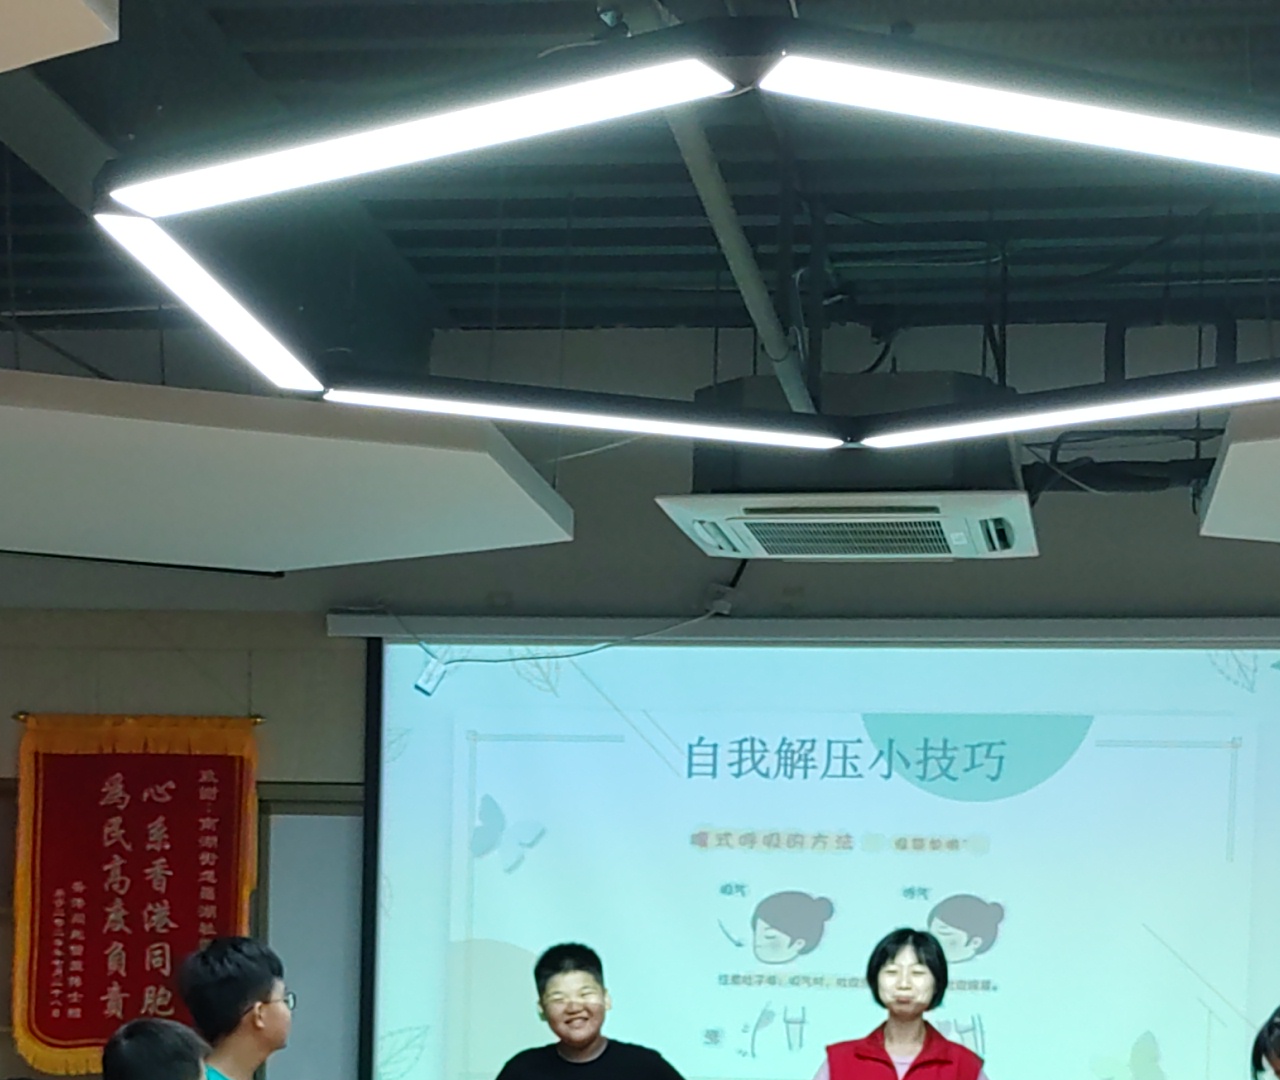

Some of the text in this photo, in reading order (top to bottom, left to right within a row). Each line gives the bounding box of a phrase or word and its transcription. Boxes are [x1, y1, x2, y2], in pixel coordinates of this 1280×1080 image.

[685, 735, 1007, 782] 自我解压小技巧
[99, 772, 132, 1020] 為民高度負責
[142, 780, 179, 1017] 心系香港同胞
